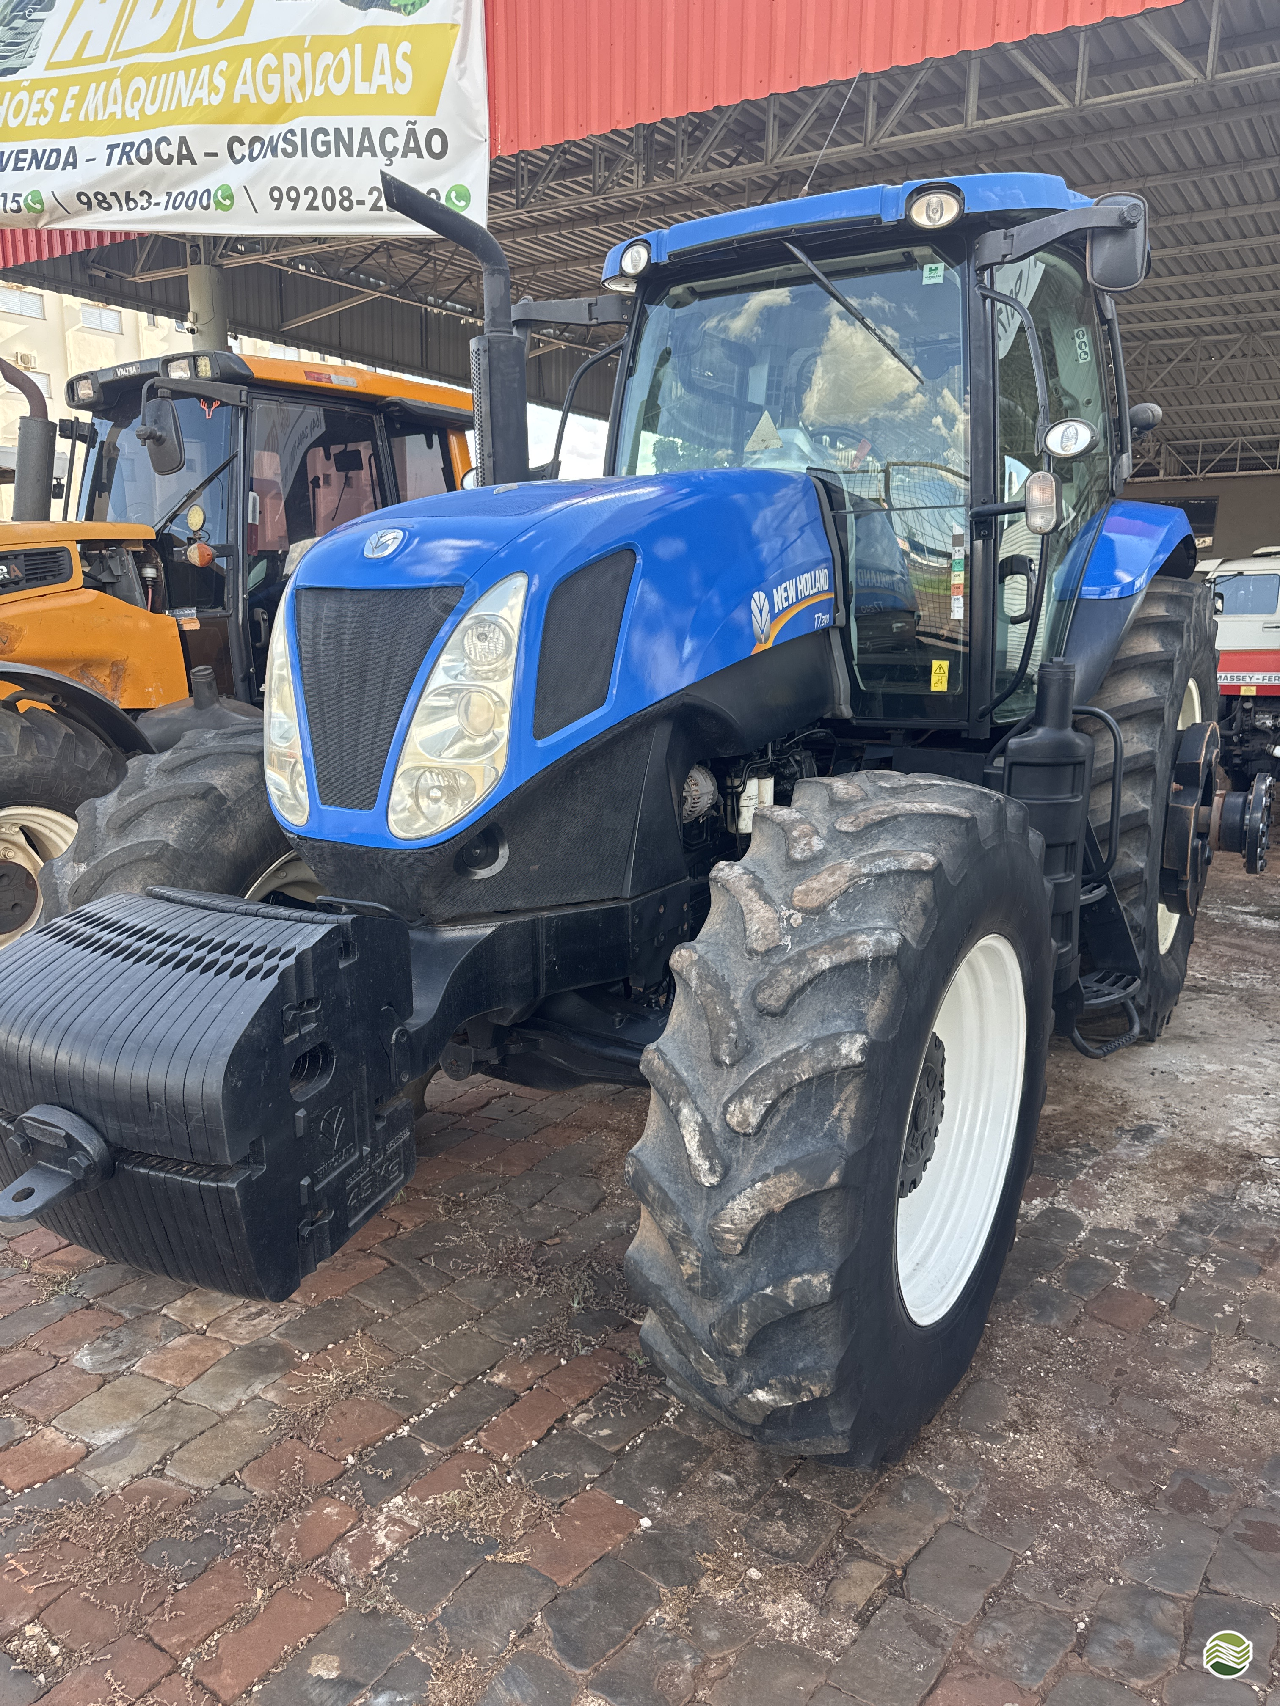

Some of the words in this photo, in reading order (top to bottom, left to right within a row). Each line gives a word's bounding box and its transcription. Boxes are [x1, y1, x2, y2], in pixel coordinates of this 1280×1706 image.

[59, 85, 81, 123] E
[79, 60, 228, 122] MÁQUINAS
[233, 35, 414, 106] AGRÍCOLAS
[0, 145, 78, 172] VENDA
[105, 136, 198, 167] TROCA
[226, 119, 449, 166] CONSIGNAÇÃO
[76, 188, 211, 212] 98163-1000
[772, 578, 797, 614] NEW
[797, 568, 829, 598] HOLLAND
